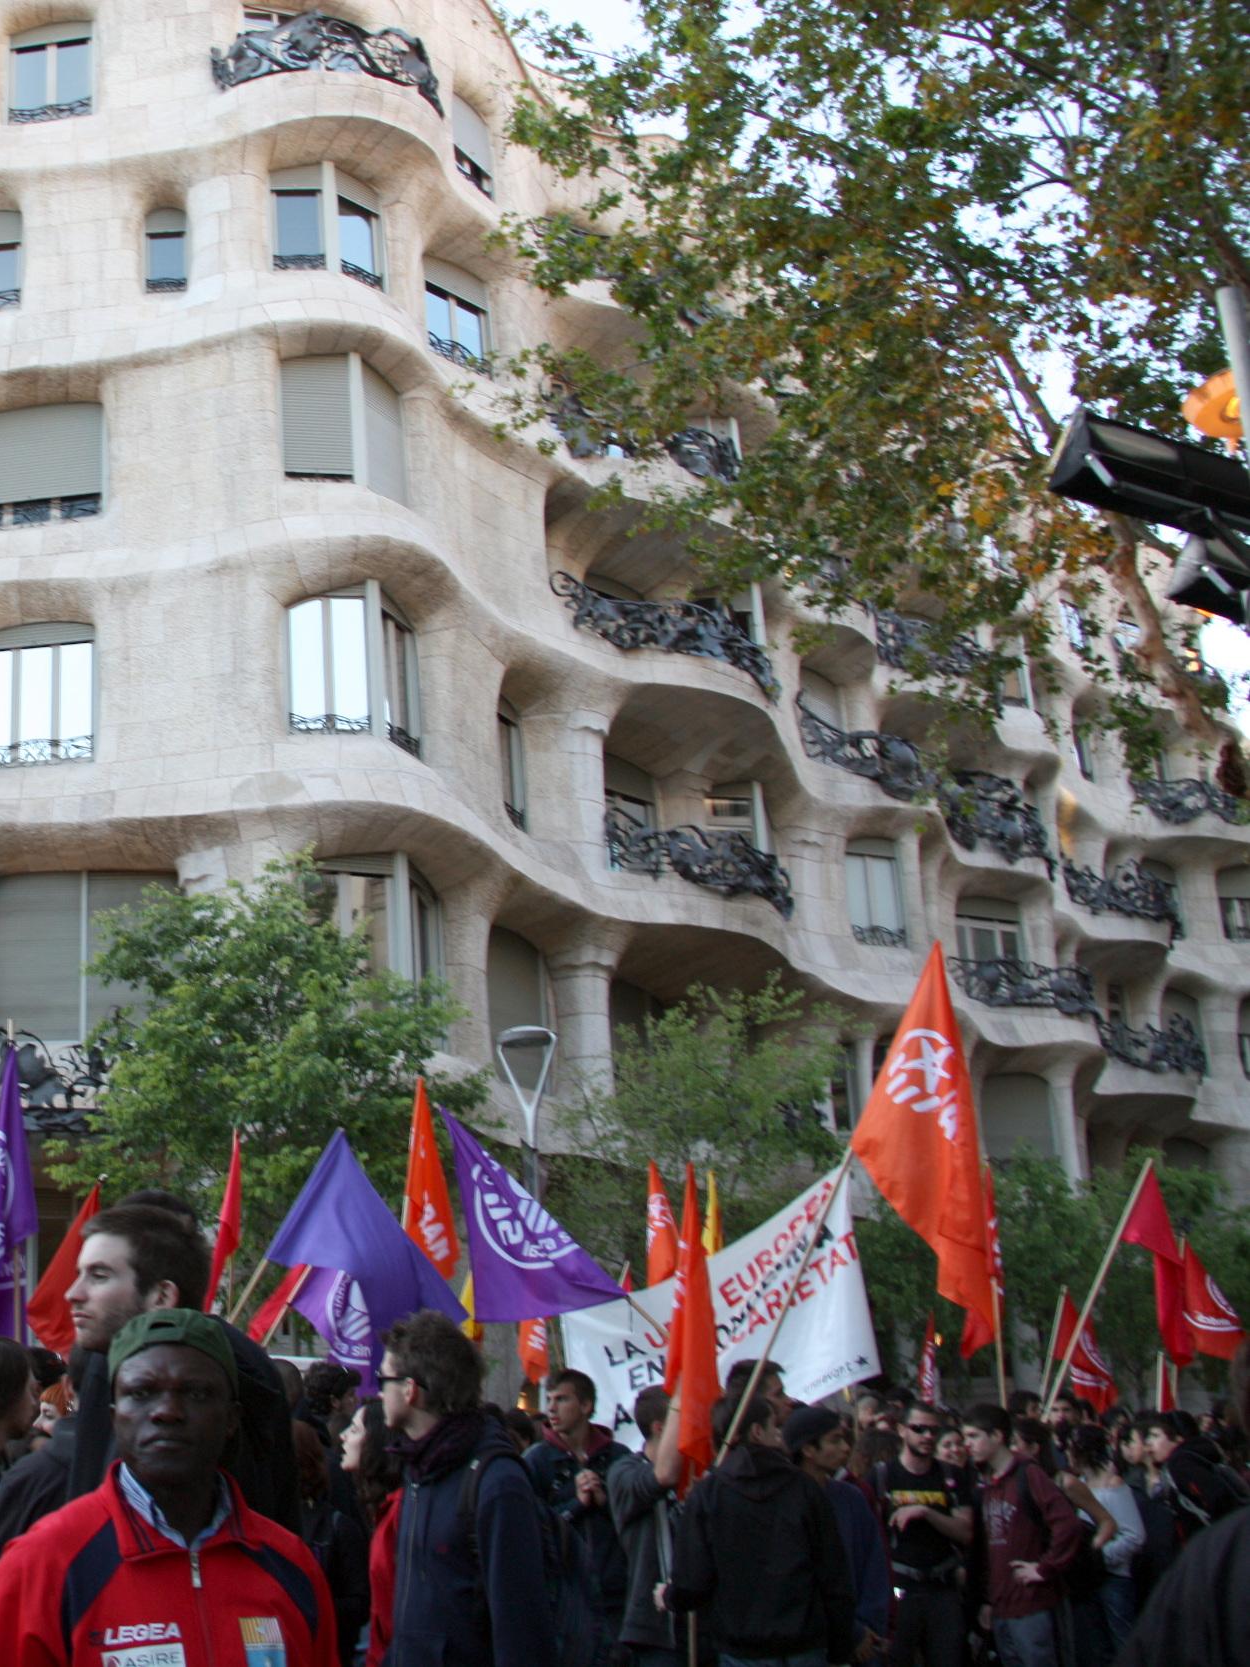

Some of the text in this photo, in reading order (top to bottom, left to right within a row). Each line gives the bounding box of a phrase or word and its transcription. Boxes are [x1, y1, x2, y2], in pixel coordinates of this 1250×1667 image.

[731, 1231, 859, 1344] CARIETAT
[603, 1339, 647, 1366] LA
[104, 1621, 182, 1646] LEGEA
[126, 1652, 182, 1667] ASIRE
